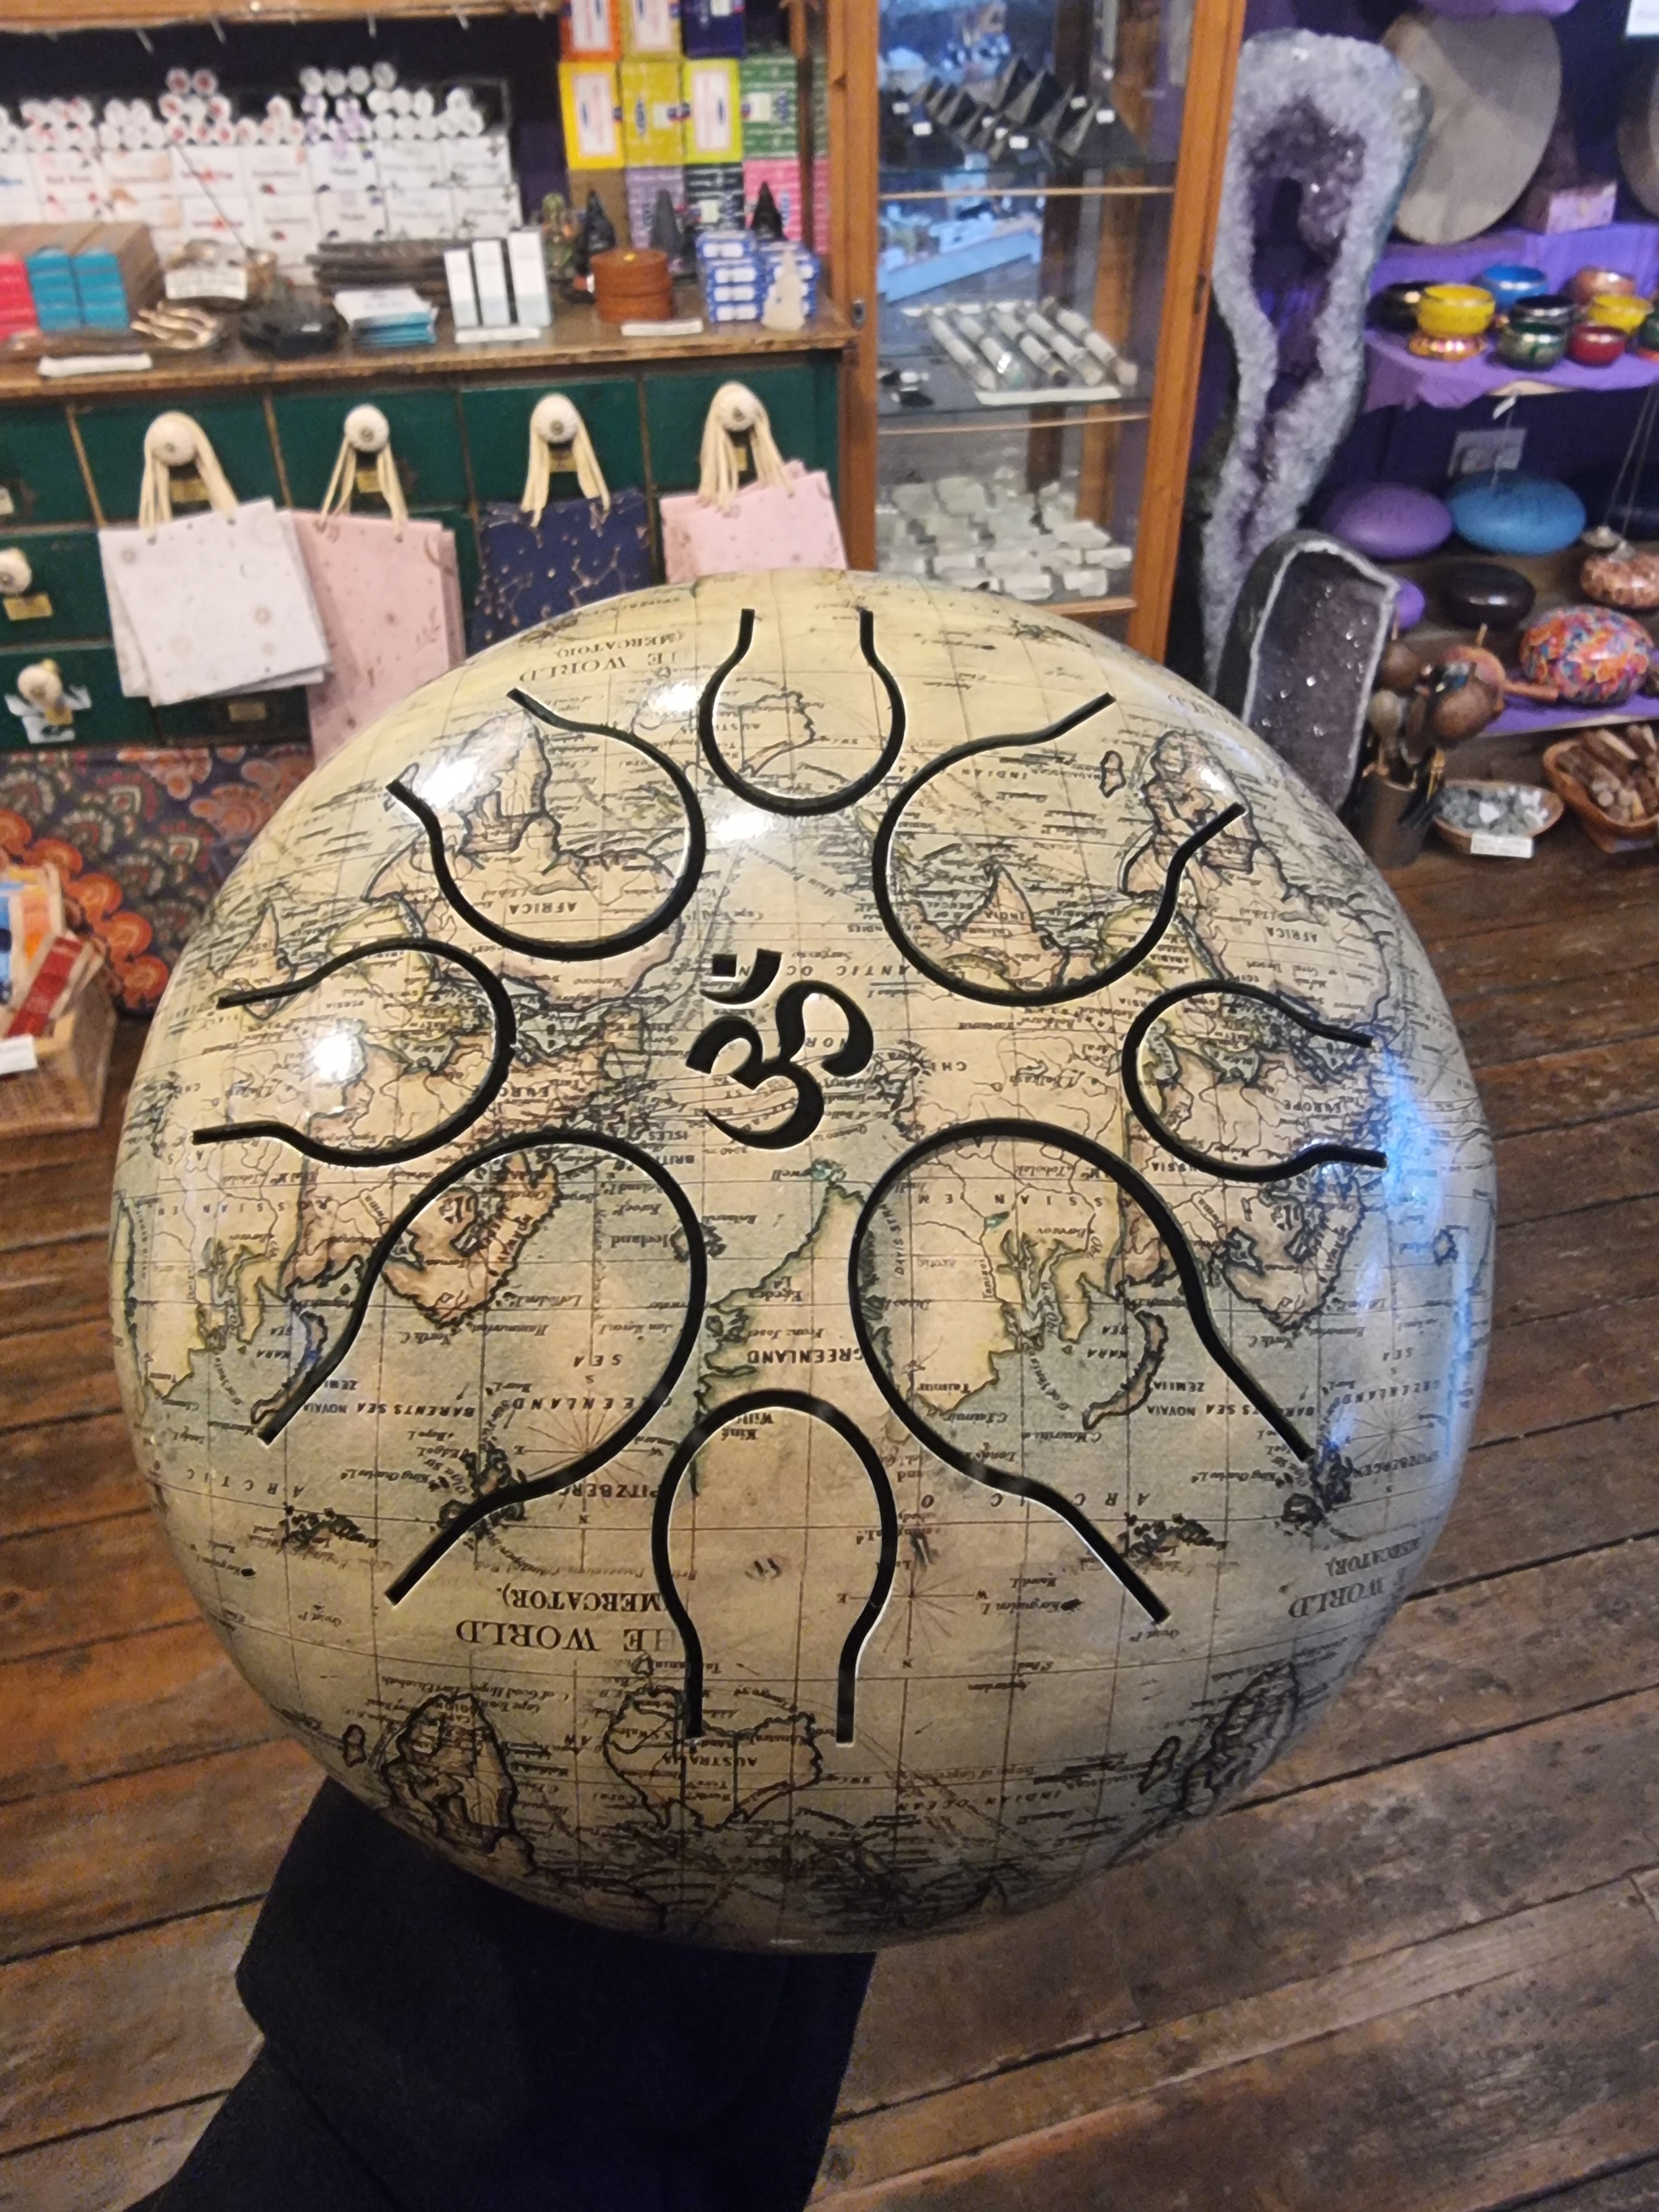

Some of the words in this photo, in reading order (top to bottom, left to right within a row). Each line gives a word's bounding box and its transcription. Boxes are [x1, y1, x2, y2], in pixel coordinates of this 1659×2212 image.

[518, 655, 627, 683] WORLD
[508, 901, 578, 916] AFRICA
[1265, 926, 1318, 943] AFRICA
[648, 1129, 688, 1141] ISLES
[611, 1234, 669, 1249] Iceland
[572, 1354, 623, 1368] SEA
[746, 1347, 864, 1366] GREENLAND
[356, 1402, 387, 1416] SEA
[393, 1403, 476, 1418] BARENTS
[1146, 1405, 1196, 1417] NOVAIA
[1205, 1402, 1236, 1416] SEA
[721, 1427, 758, 1442] King
[186, 1468, 305, 1499] ARCTIC
[989, 1492, 1151, 1506] ARCIC
[455, 1619, 600, 1652] WORLD
